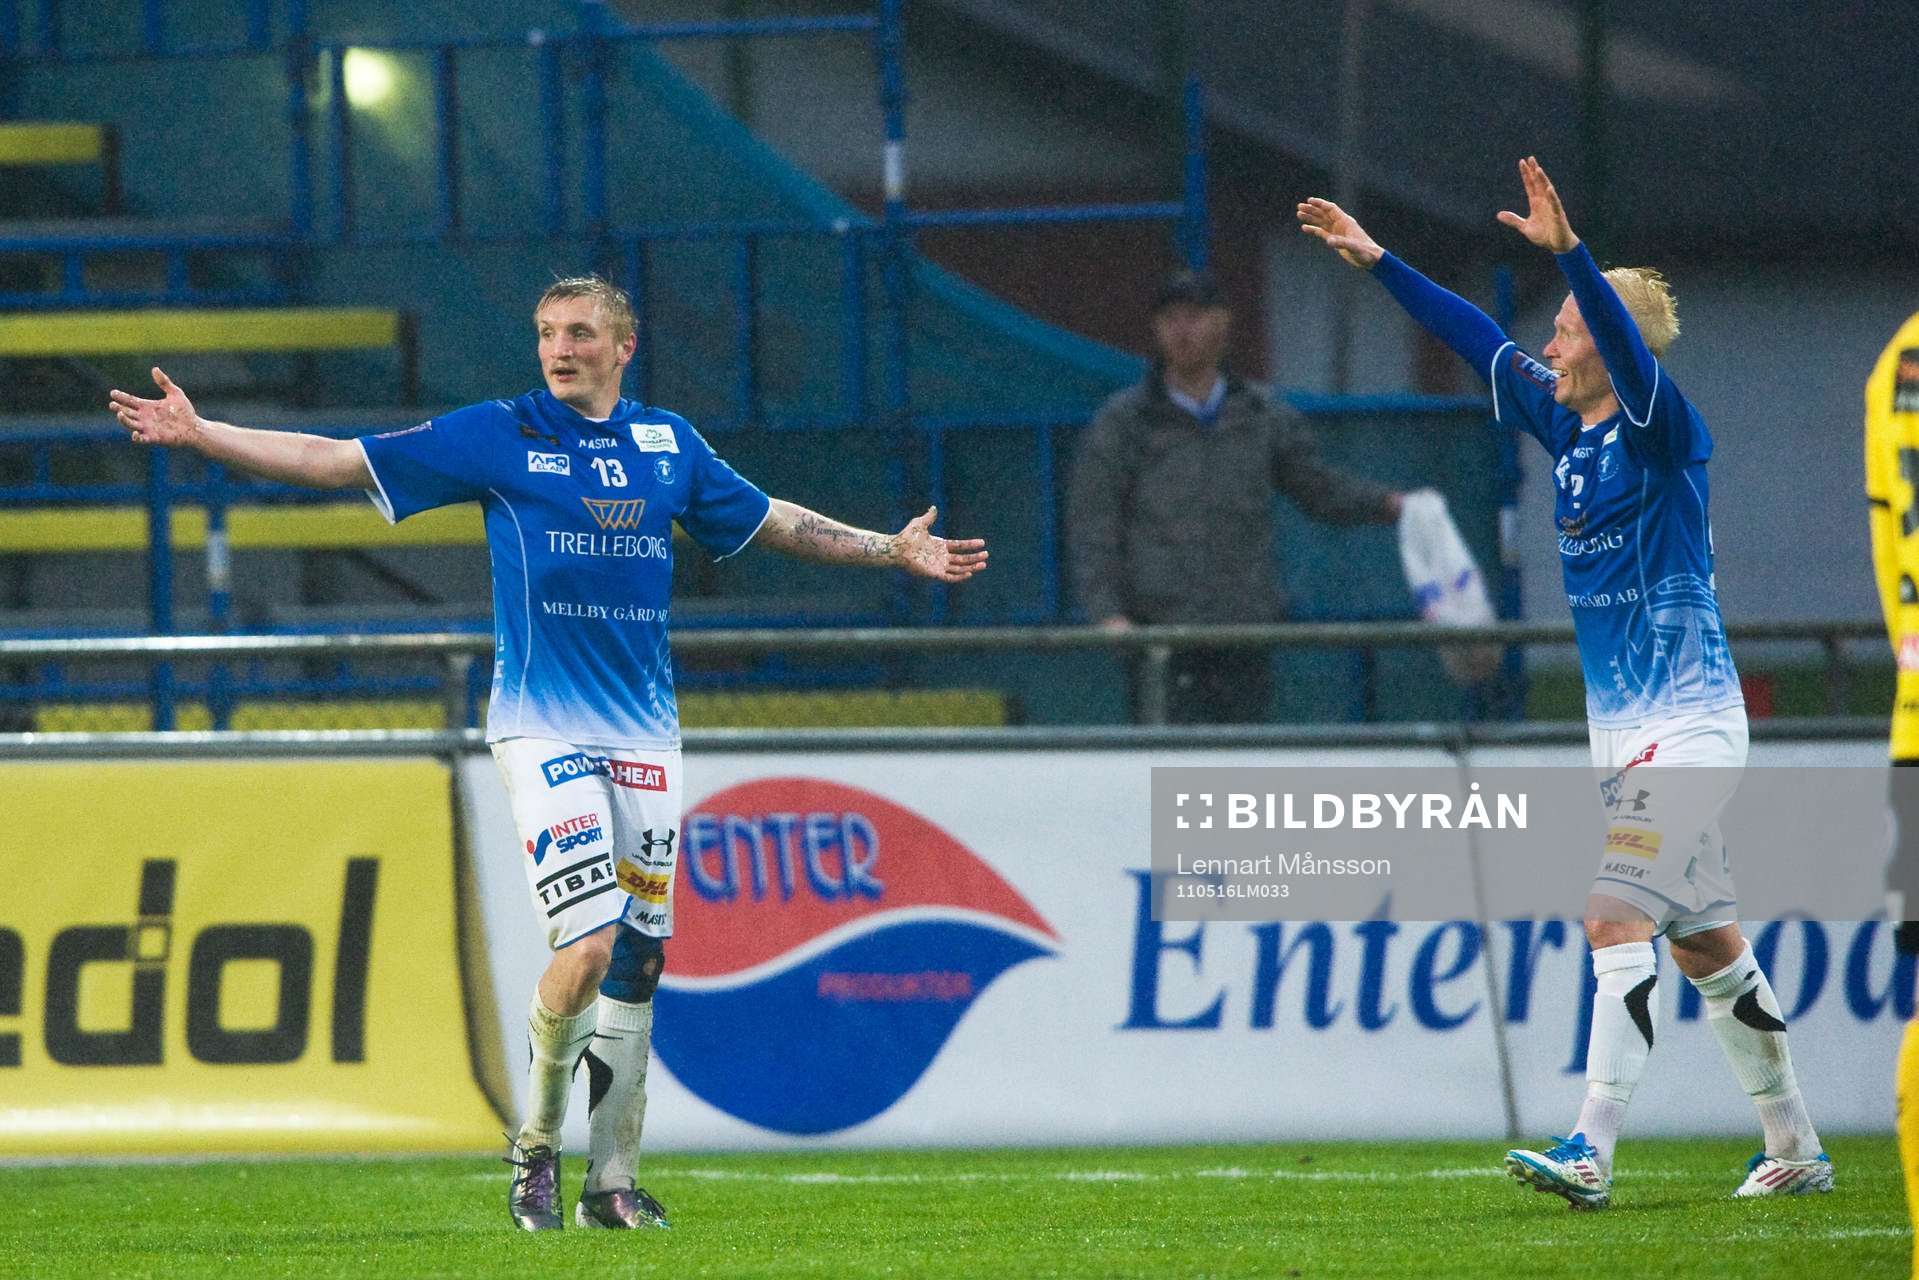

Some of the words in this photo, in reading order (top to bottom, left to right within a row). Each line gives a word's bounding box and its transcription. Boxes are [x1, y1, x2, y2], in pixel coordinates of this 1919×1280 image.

[590, 456, 629, 487] 13
[546, 531, 668, 560] TRELLEBORG
[1615, 588, 1639, 605] AB
[542, 601, 610, 620] MELLBY
[613, 603, 655, 622] GÅRD
[616, 766, 662, 788] HEAT
[550, 813, 599, 840] INTER
[555, 826, 603, 854] SPORT
[684, 812, 885, 904] ENTER
[1604, 862, 1645, 879] MASITA
[0, 856, 382, 1068] dol
